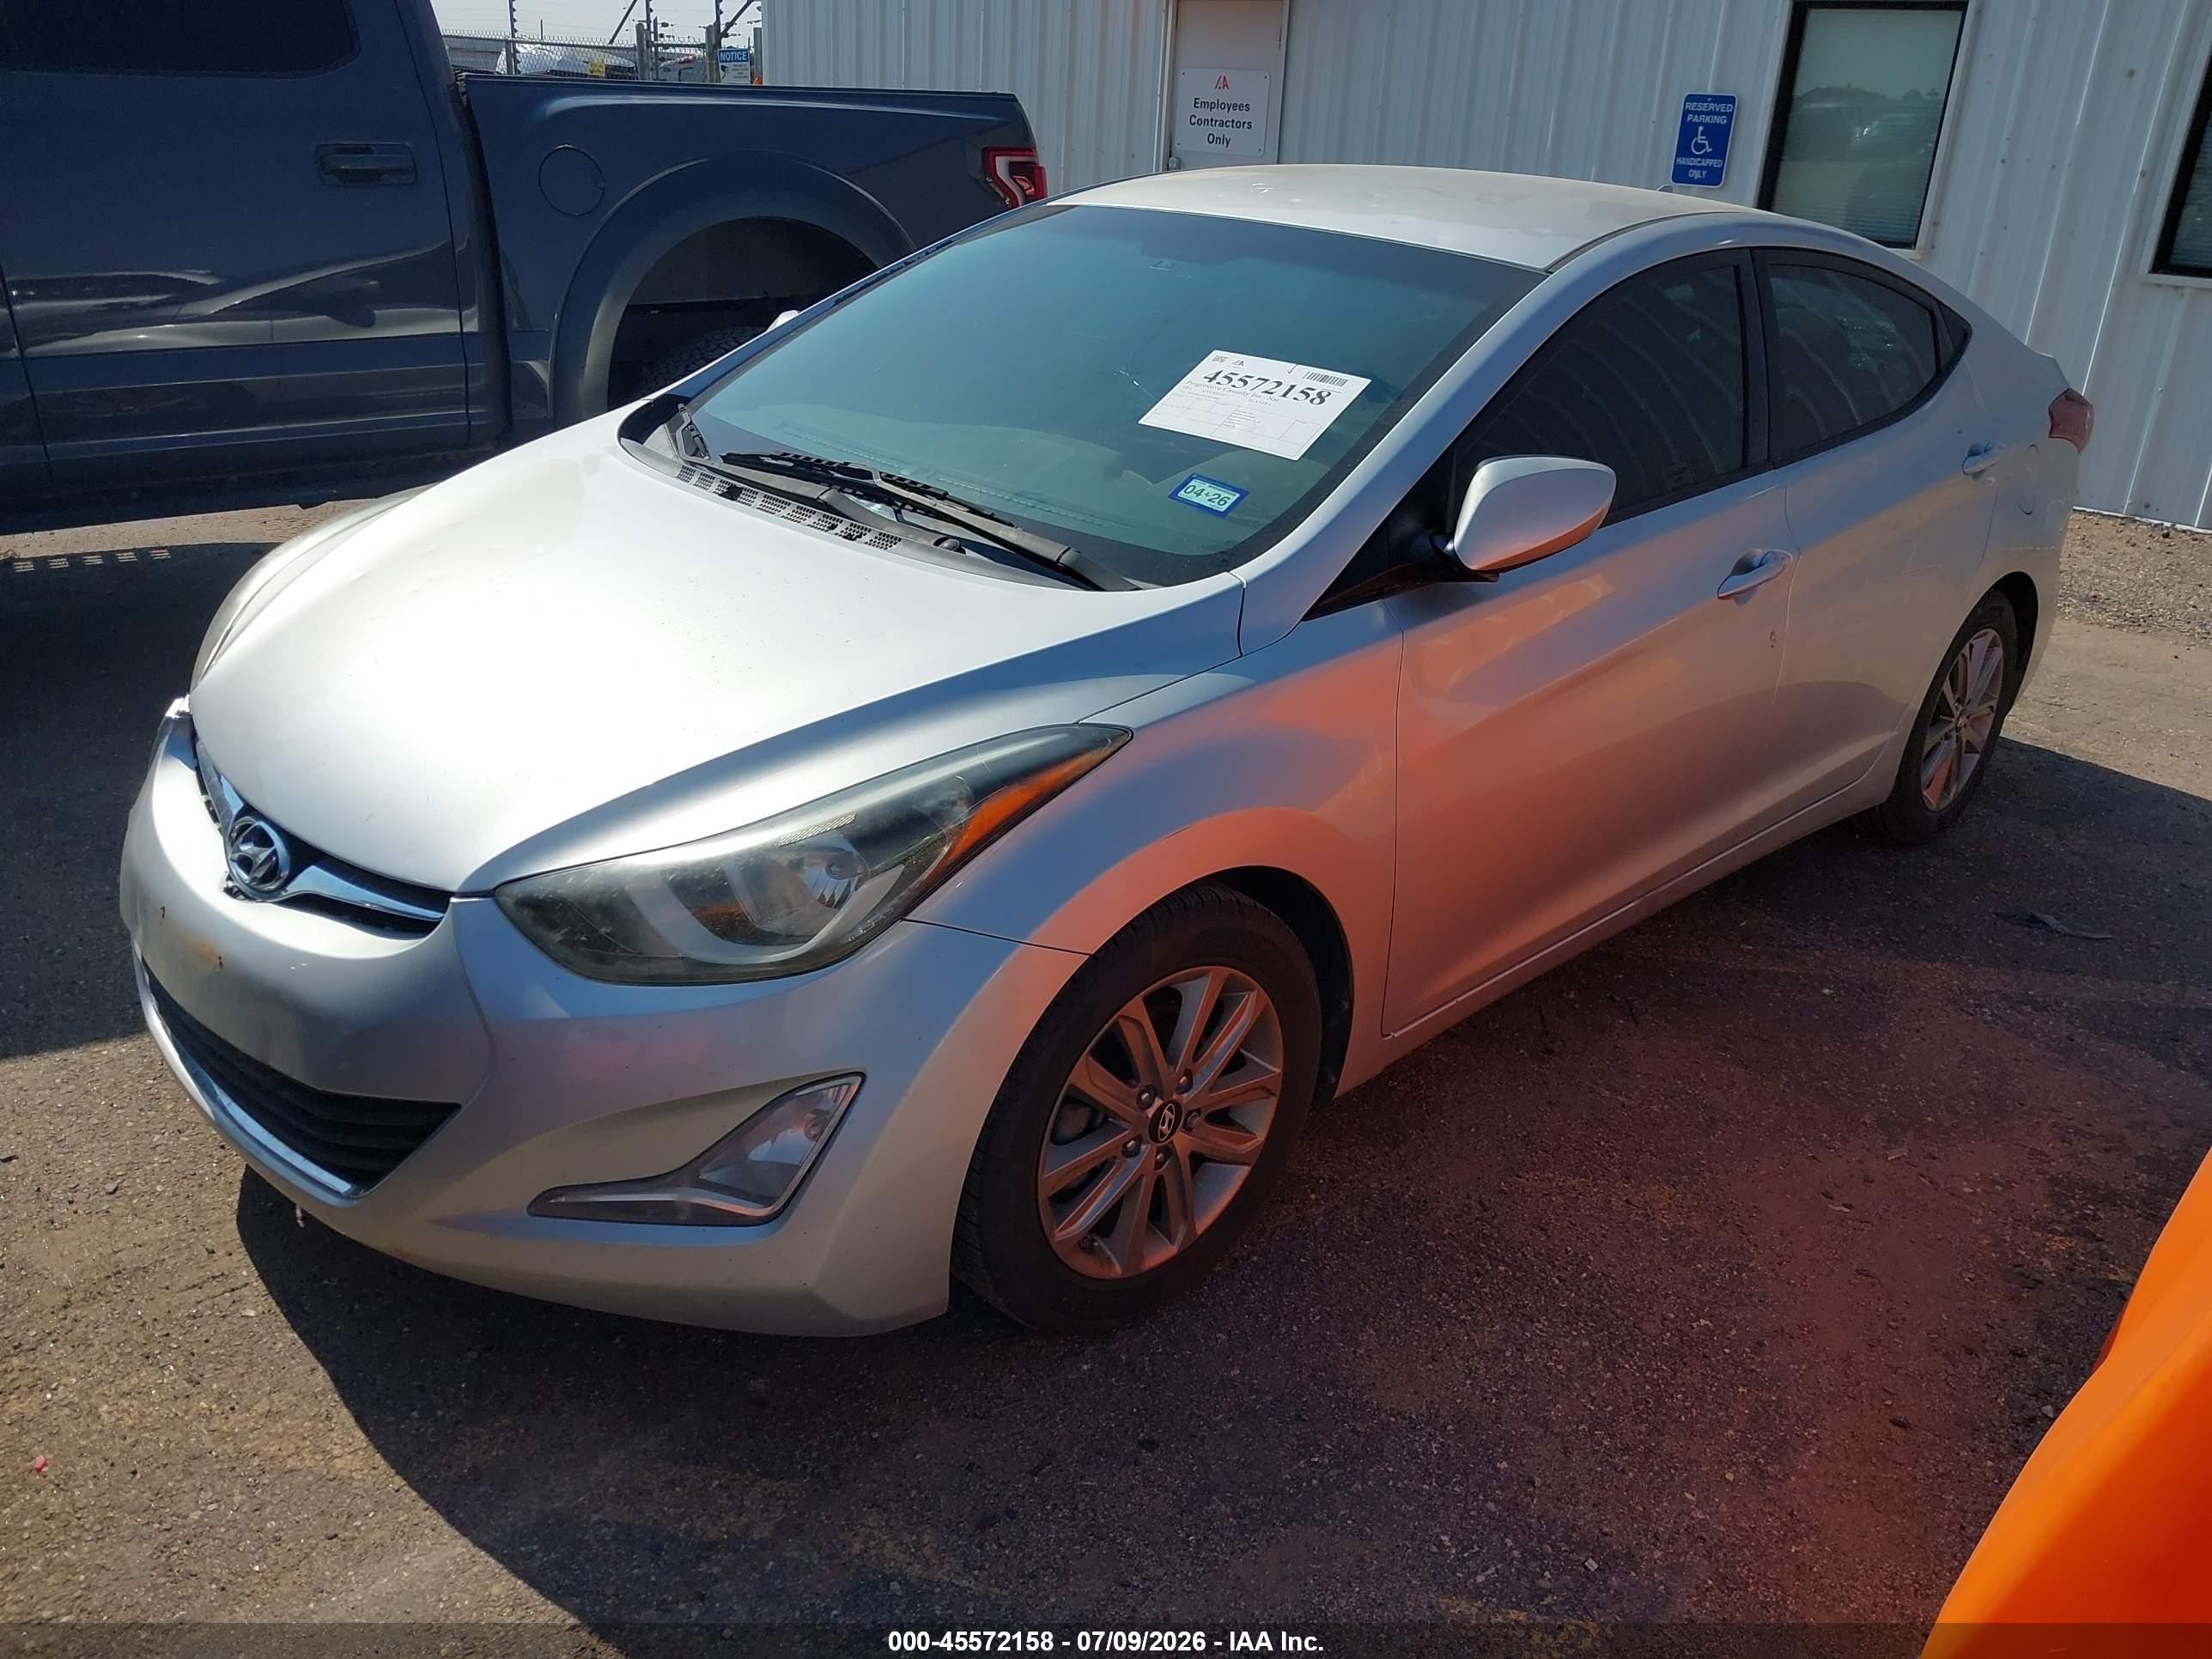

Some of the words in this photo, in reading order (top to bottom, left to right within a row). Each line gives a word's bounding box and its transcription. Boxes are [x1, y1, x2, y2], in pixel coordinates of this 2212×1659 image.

[720, 51, 748, 62] NOTICE
[1194, 97, 1251, 113] Employees
[1685, 102, 1734, 112] RESERVED
[1188, 114, 1253, 130] Contractors
[1686, 114, 1728, 125] PARKING
[1206, 132, 1231, 149] Only
[1675, 157, 1724, 167] HANDICAPPED
[1688, 169, 1707, 179] ONLY
[1203, 370, 1332, 405] 45572158
[1183, 484, 1206, 498] 04
[1207, 493, 1231, 507] 26
